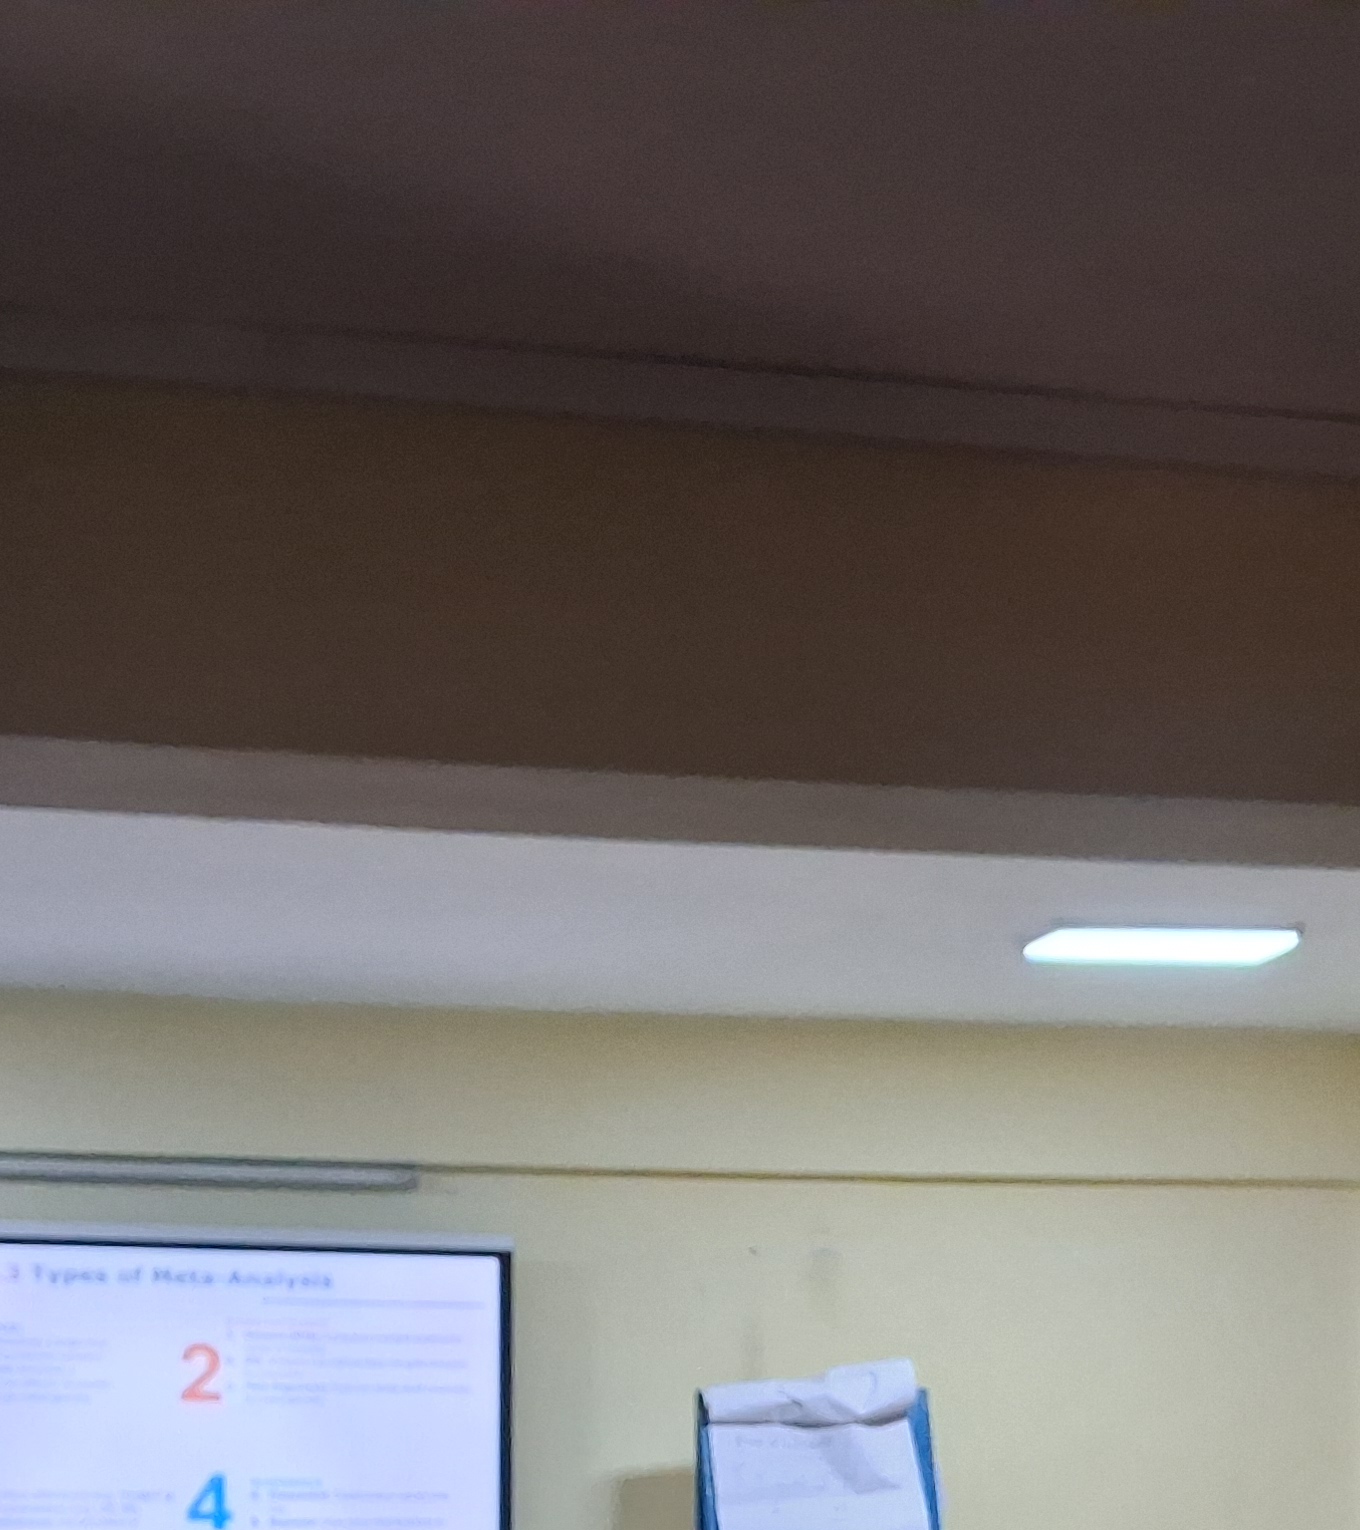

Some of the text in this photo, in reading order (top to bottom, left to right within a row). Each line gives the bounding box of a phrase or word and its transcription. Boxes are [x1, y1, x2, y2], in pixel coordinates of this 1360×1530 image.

[32, 1263, 108, 1288] Types
[117, 1265, 143, 1284] of
[181, 1342, 221, 1402] 2
[187, 1475, 231, 1530] 4
